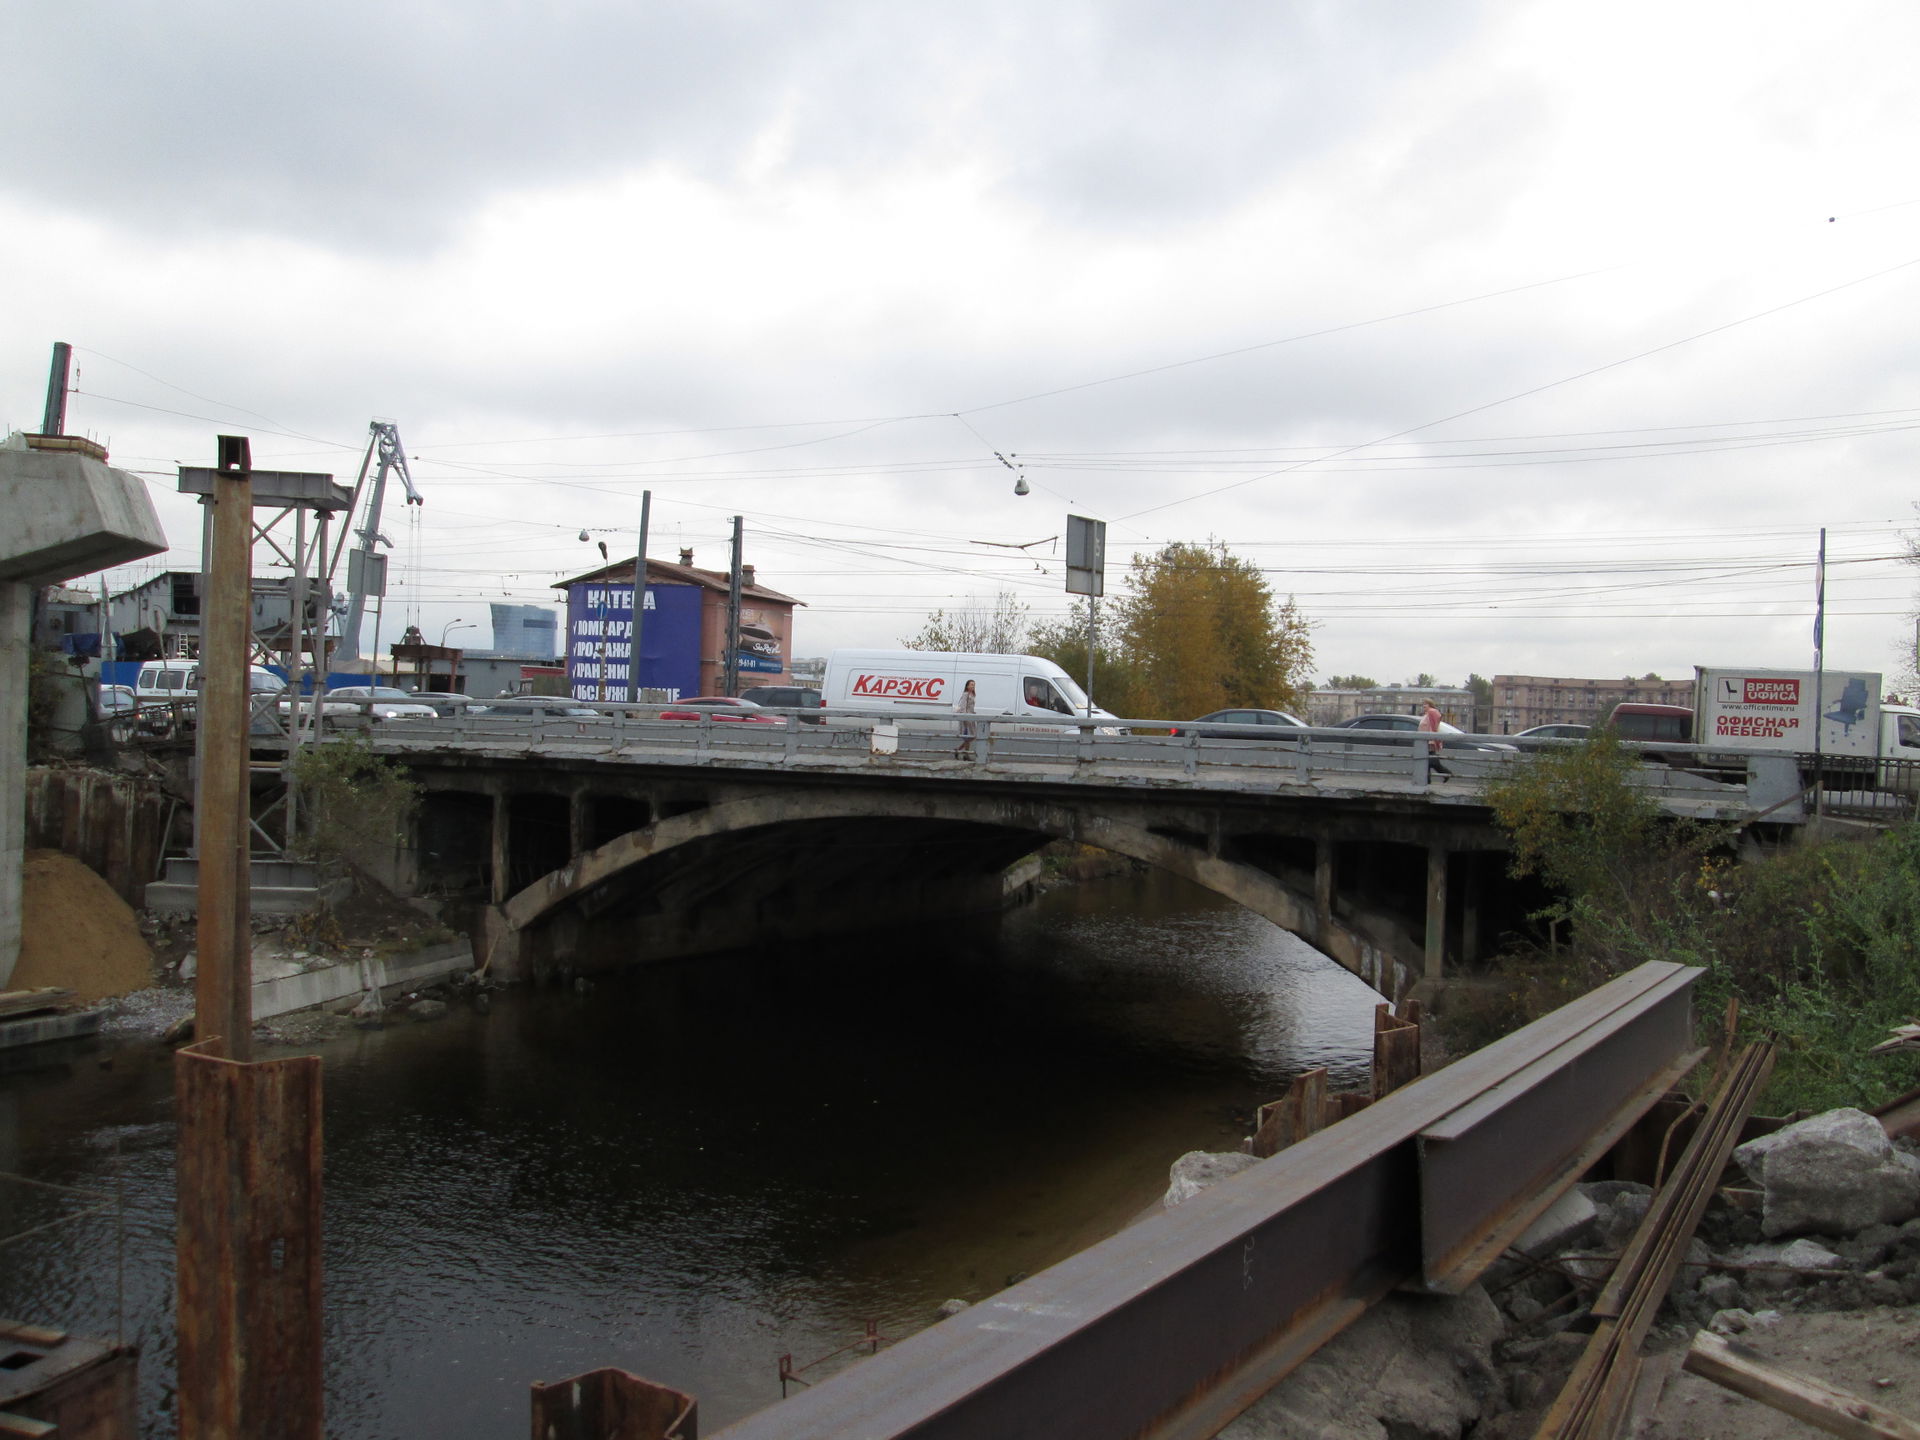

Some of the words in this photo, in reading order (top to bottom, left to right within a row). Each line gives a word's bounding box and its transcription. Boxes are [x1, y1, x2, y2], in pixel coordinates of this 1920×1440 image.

[587, 590, 656, 610] КАТЕА
[576, 662, 630, 679] ХРАННИ
[1746, 682, 1794, 692] ВРЕМЯ
[1748, 691, 1797, 701] ОФИСА
[1722, 704, 1795, 712] www.officetime.ru
[1717, 715, 1799, 728] ОФИСНАЯ
[1716, 725, 1784, 737] МЕБЕЛЬ
